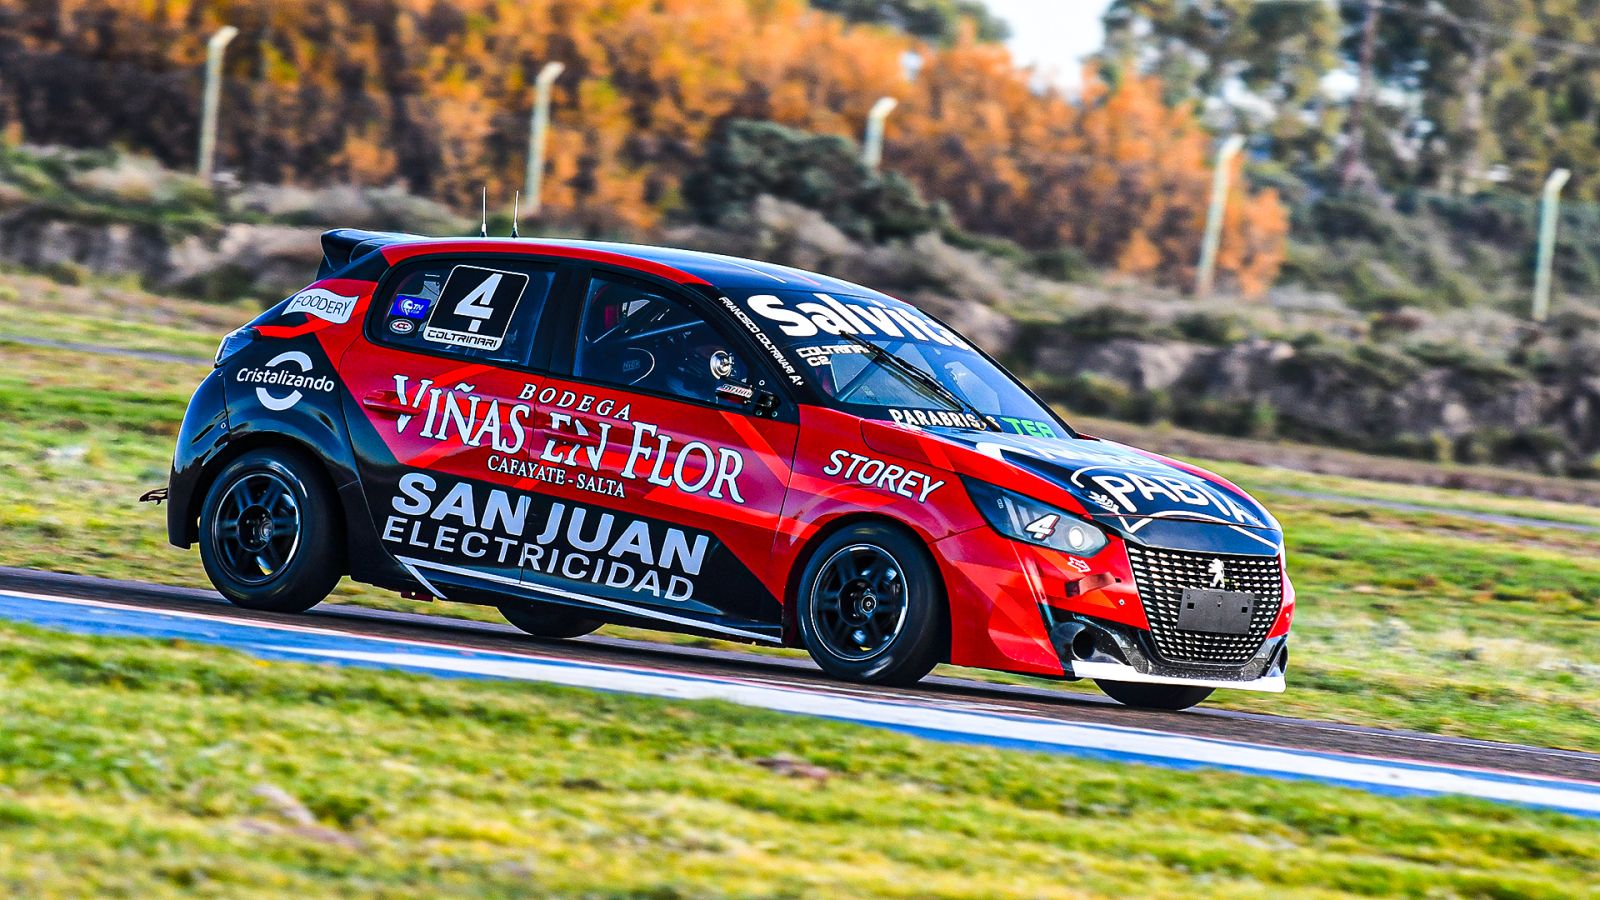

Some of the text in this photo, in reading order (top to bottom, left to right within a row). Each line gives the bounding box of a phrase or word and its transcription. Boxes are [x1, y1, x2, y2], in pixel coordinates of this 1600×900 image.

[291, 295, 352, 317] FOODERY
[453, 273, 503, 333] 4
[427, 329, 497, 348] COLTRINARI
[796, 344, 871, 358] COLTRINA
[236, 368, 335, 392] Cristalizando
[519, 383, 631, 421] BODEGA
[888, 408, 1000, 430] PARABRISS
[393, 374, 745, 503] VIÑAS EN FLOR
[822, 449, 945, 503] STOREY
[392, 472, 709, 576] SAN JUAN
[1024, 513, 1061, 540] 4
[381, 515, 694, 602] ELECTRICIDAD
